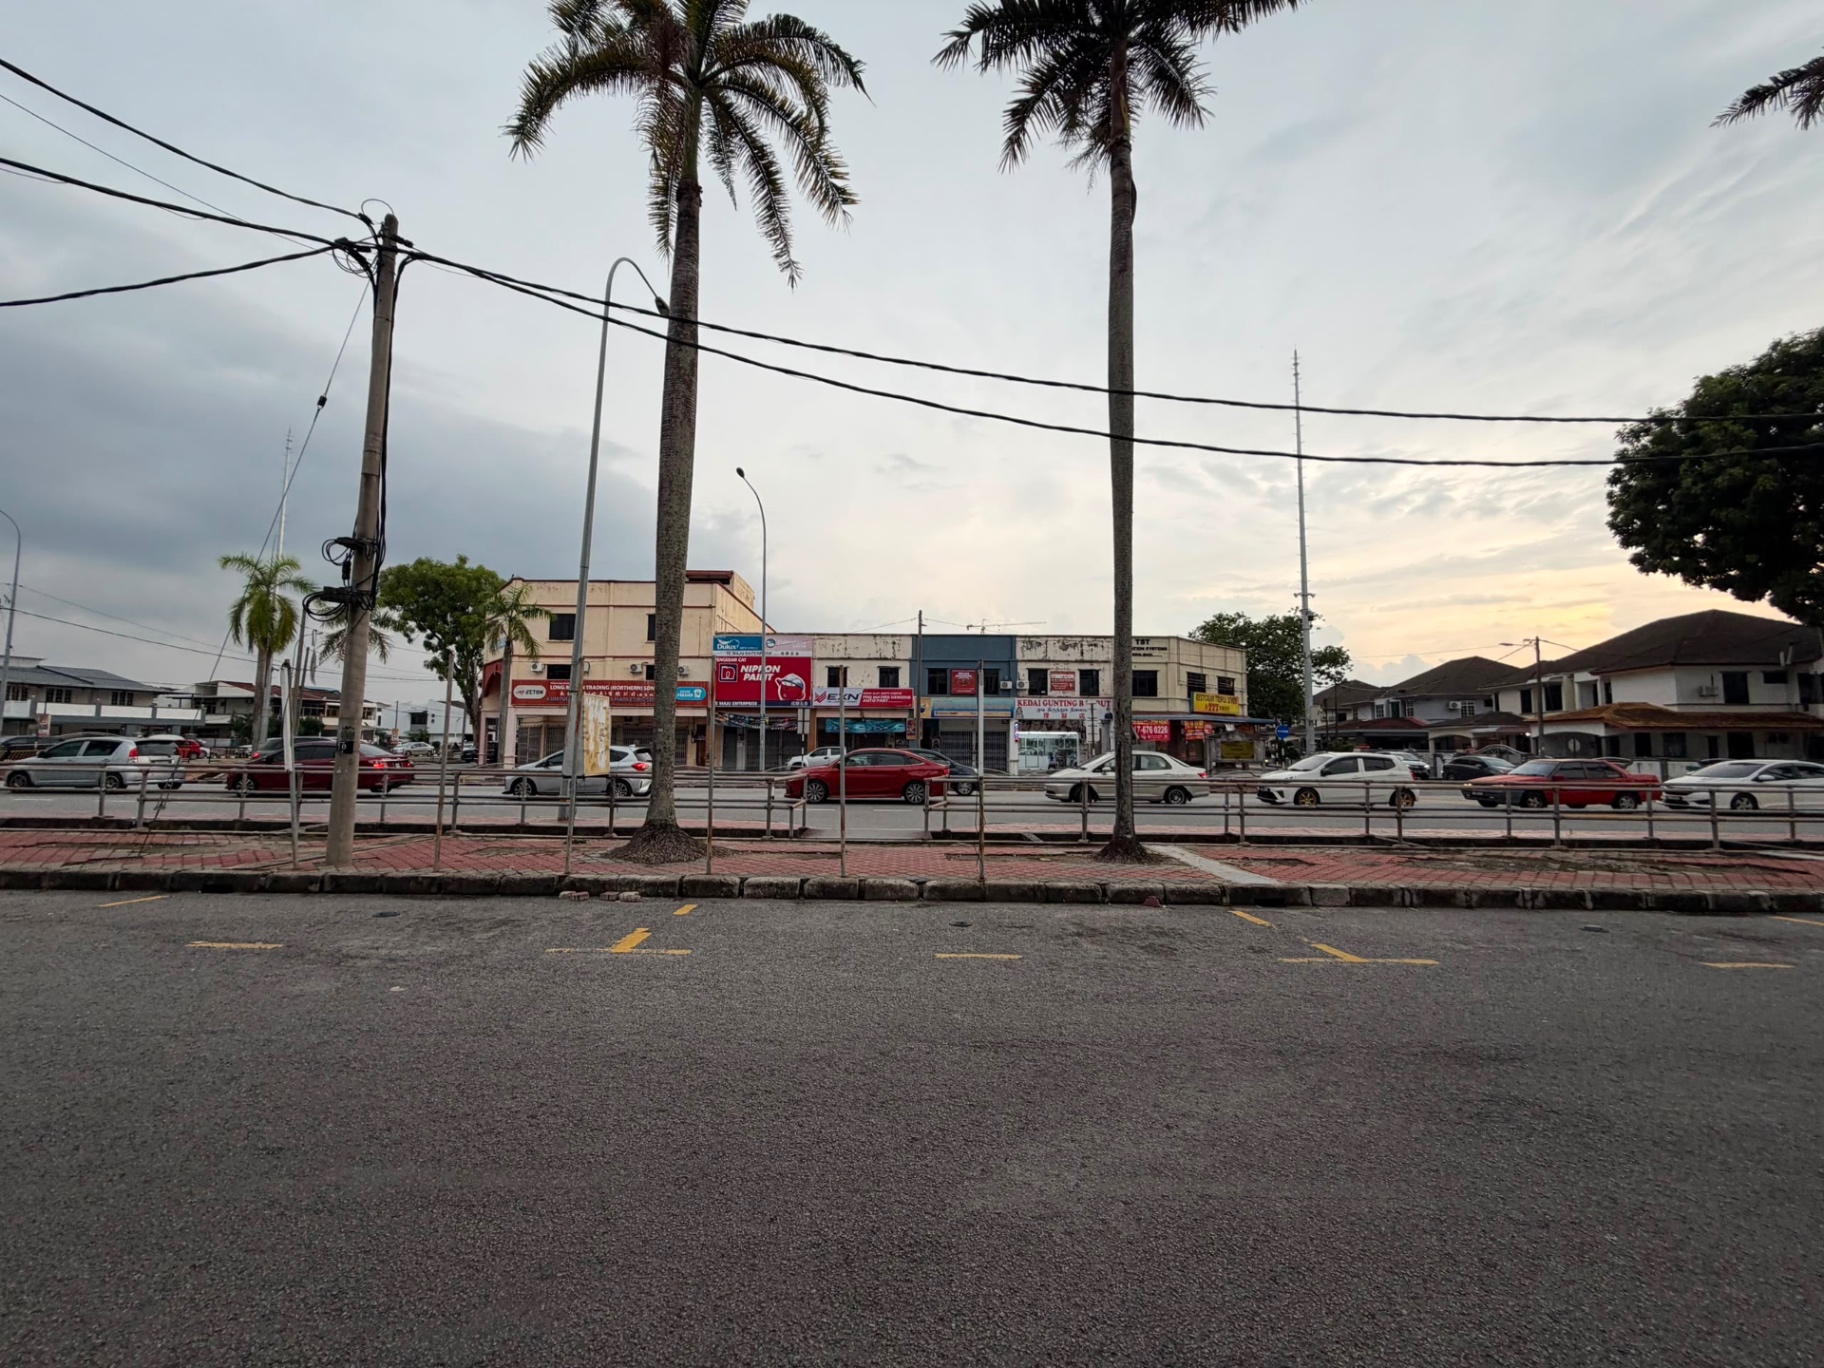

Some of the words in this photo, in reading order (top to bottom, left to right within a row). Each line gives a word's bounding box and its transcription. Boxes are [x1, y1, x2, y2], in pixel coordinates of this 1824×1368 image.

[1017, 699, 1041, 707] KEDAI
[1042, 699, 1077, 707] GUNTING
[1208, 703, 1219, 712] 777
